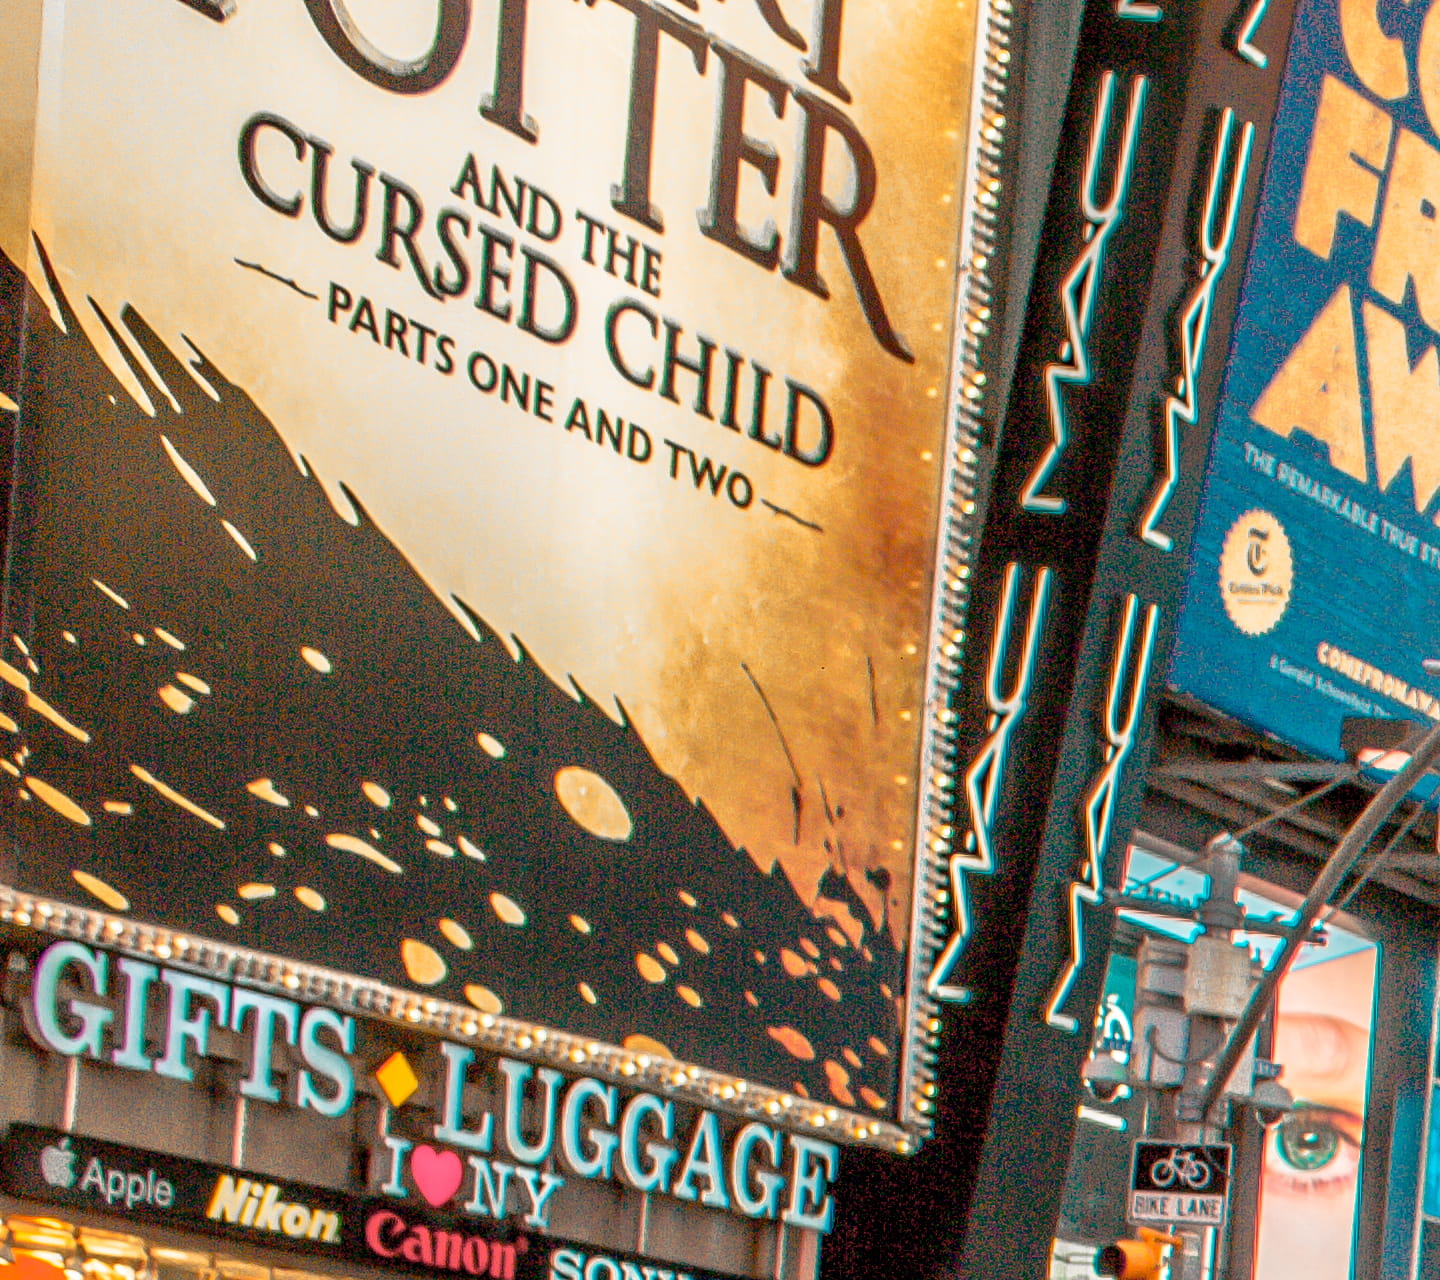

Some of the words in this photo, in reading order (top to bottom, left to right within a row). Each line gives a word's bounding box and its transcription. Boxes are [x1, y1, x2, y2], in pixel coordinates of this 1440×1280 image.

[135, 0, 915, 363] TTER
[452, 153, 565, 242] AND
[576, 210, 662, 297] THE
[238, 111, 578, 344] CURSED
[605, 297, 834, 468] CHILD
[326, 283, 454, 374] PARTS
[467, 351, 555, 421] ONE
[564, 397, 652, 466] AND
[664, 439, 755, 510] TWO
[1245, 441, 1277, 478] THE
[1381, 519, 1420, 558] TRUE
[32, 939, 355, 1118] GIFTS
[434, 1039, 841, 1235] LUGGAGE
[79, 1154, 175, 1210] Apple
[206, 1173, 342, 1245] Nikon
[380, 1137, 412, 1200] I
[464, 1154, 566, 1232] NY
[1134, 1195, 1169, 1217] BIKE
[1177, 1197, 1221, 1219] LANE
